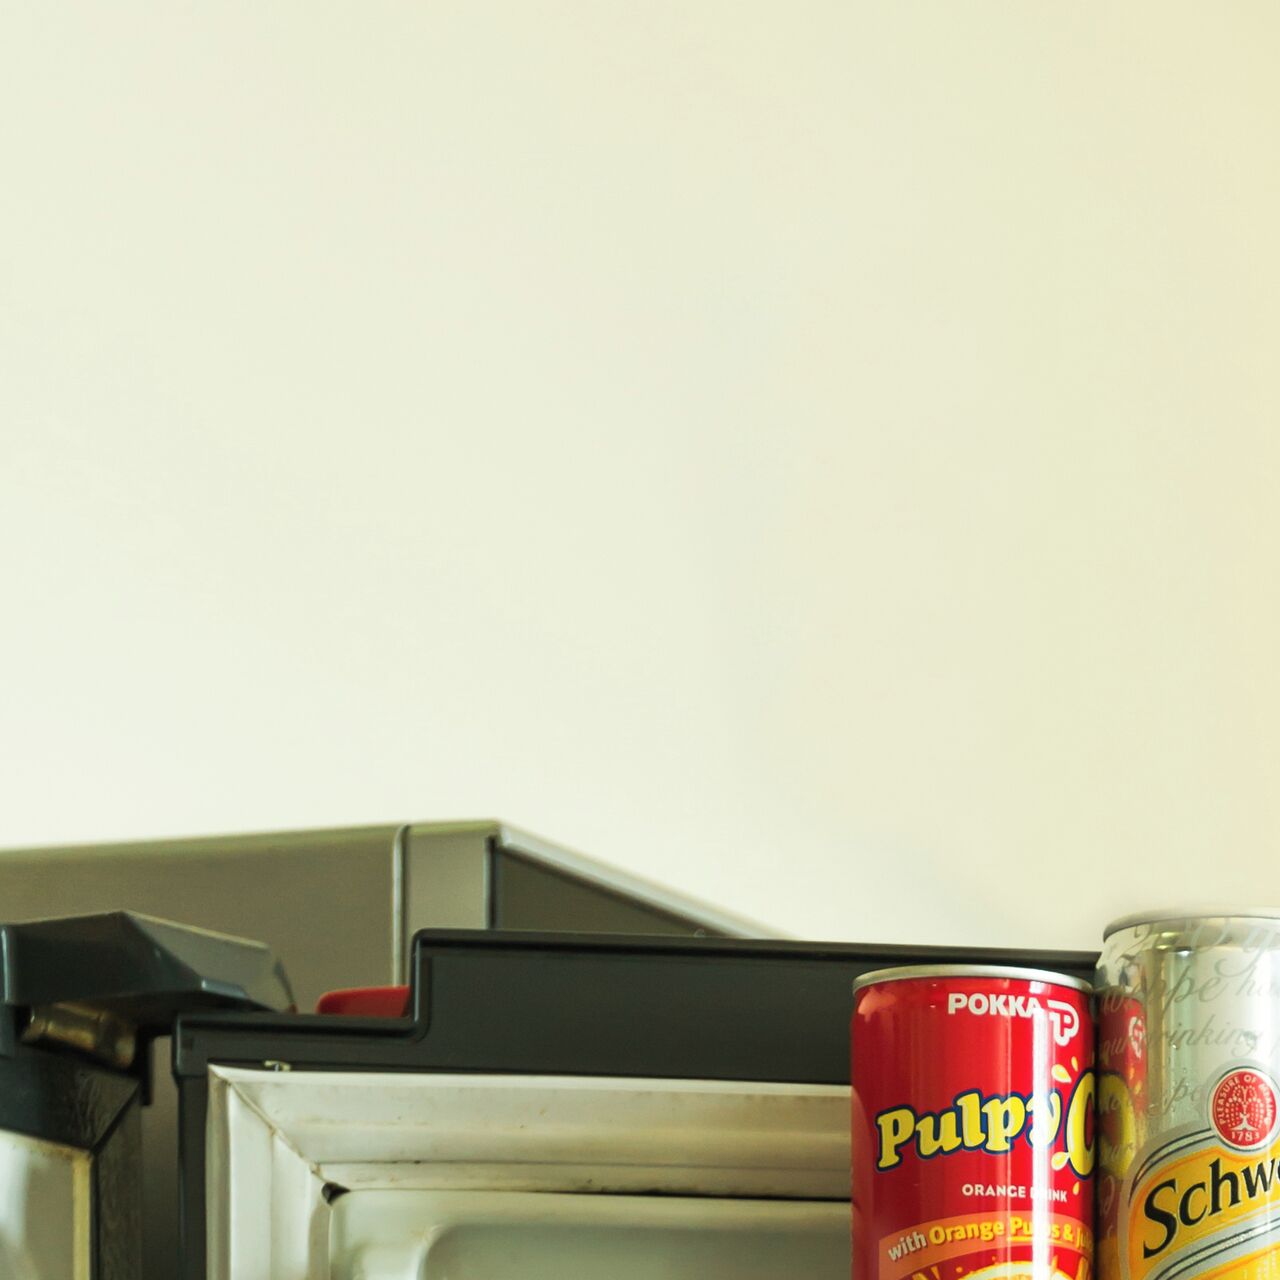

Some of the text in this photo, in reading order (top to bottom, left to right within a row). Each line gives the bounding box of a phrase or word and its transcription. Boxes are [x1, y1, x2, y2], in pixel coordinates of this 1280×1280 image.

[948, 993, 1044, 1018] POKKA
[1217, 1076, 1240, 1125] PLEASURE
[1244, 1074, 1257, 1084] OF
[876, 1089, 1061, 1171] Pulpy
[1231, 1131, 1260, 1142] 1783
[962, 1184, 1026, 1198] ORANGE
[888, 1231, 927, 1262] with
[929, 1221, 1005, 1245] Orange
[1009, 1216, 1060, 1239] Pus
